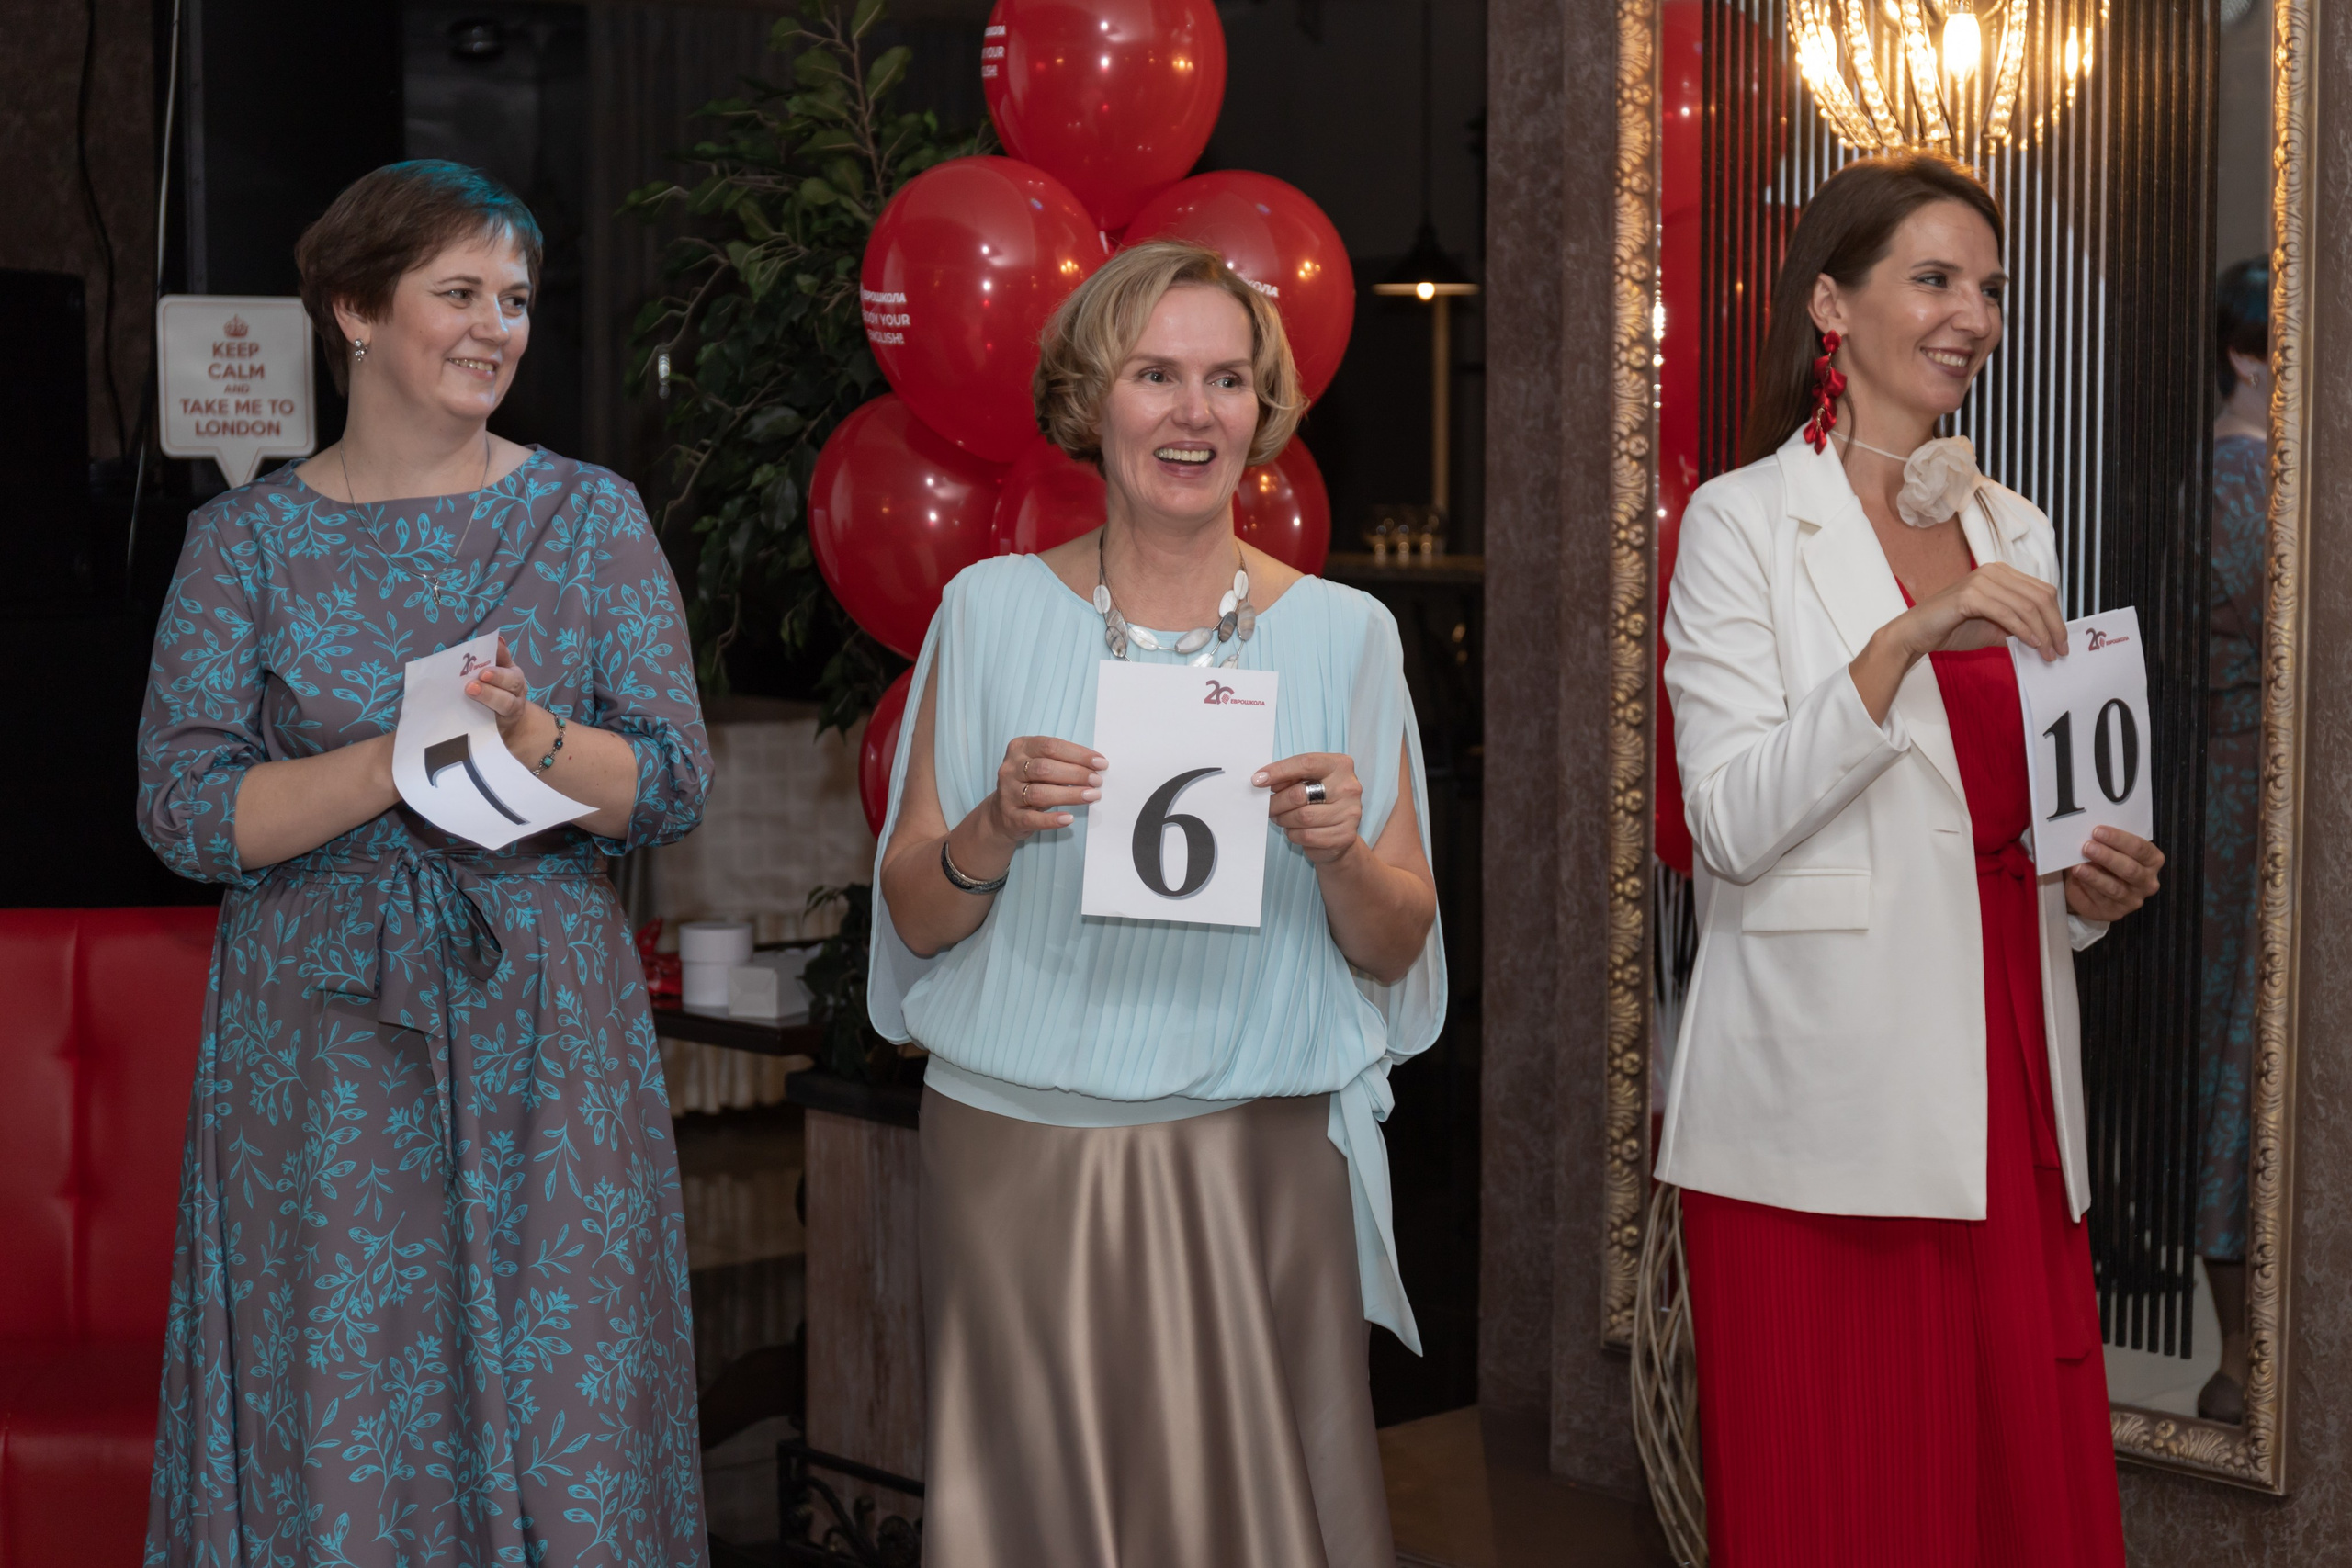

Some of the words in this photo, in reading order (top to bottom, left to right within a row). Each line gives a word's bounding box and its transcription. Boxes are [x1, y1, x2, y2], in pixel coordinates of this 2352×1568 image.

[879, 313, 910, 327] YOUR
[212, 342, 260, 357] KEEP
[208, 363, 265, 379] CALM
[223, 384, 250, 395] AND
[180, 398, 229, 414] TAKE
[234, 399, 262, 414] ME
[268, 399, 295, 414] TO
[195, 420, 281, 436] LONDON
[2042, 698, 2140, 820] 10
[424, 733, 530, 826] 7
[1132, 767, 1225, 900] 6
